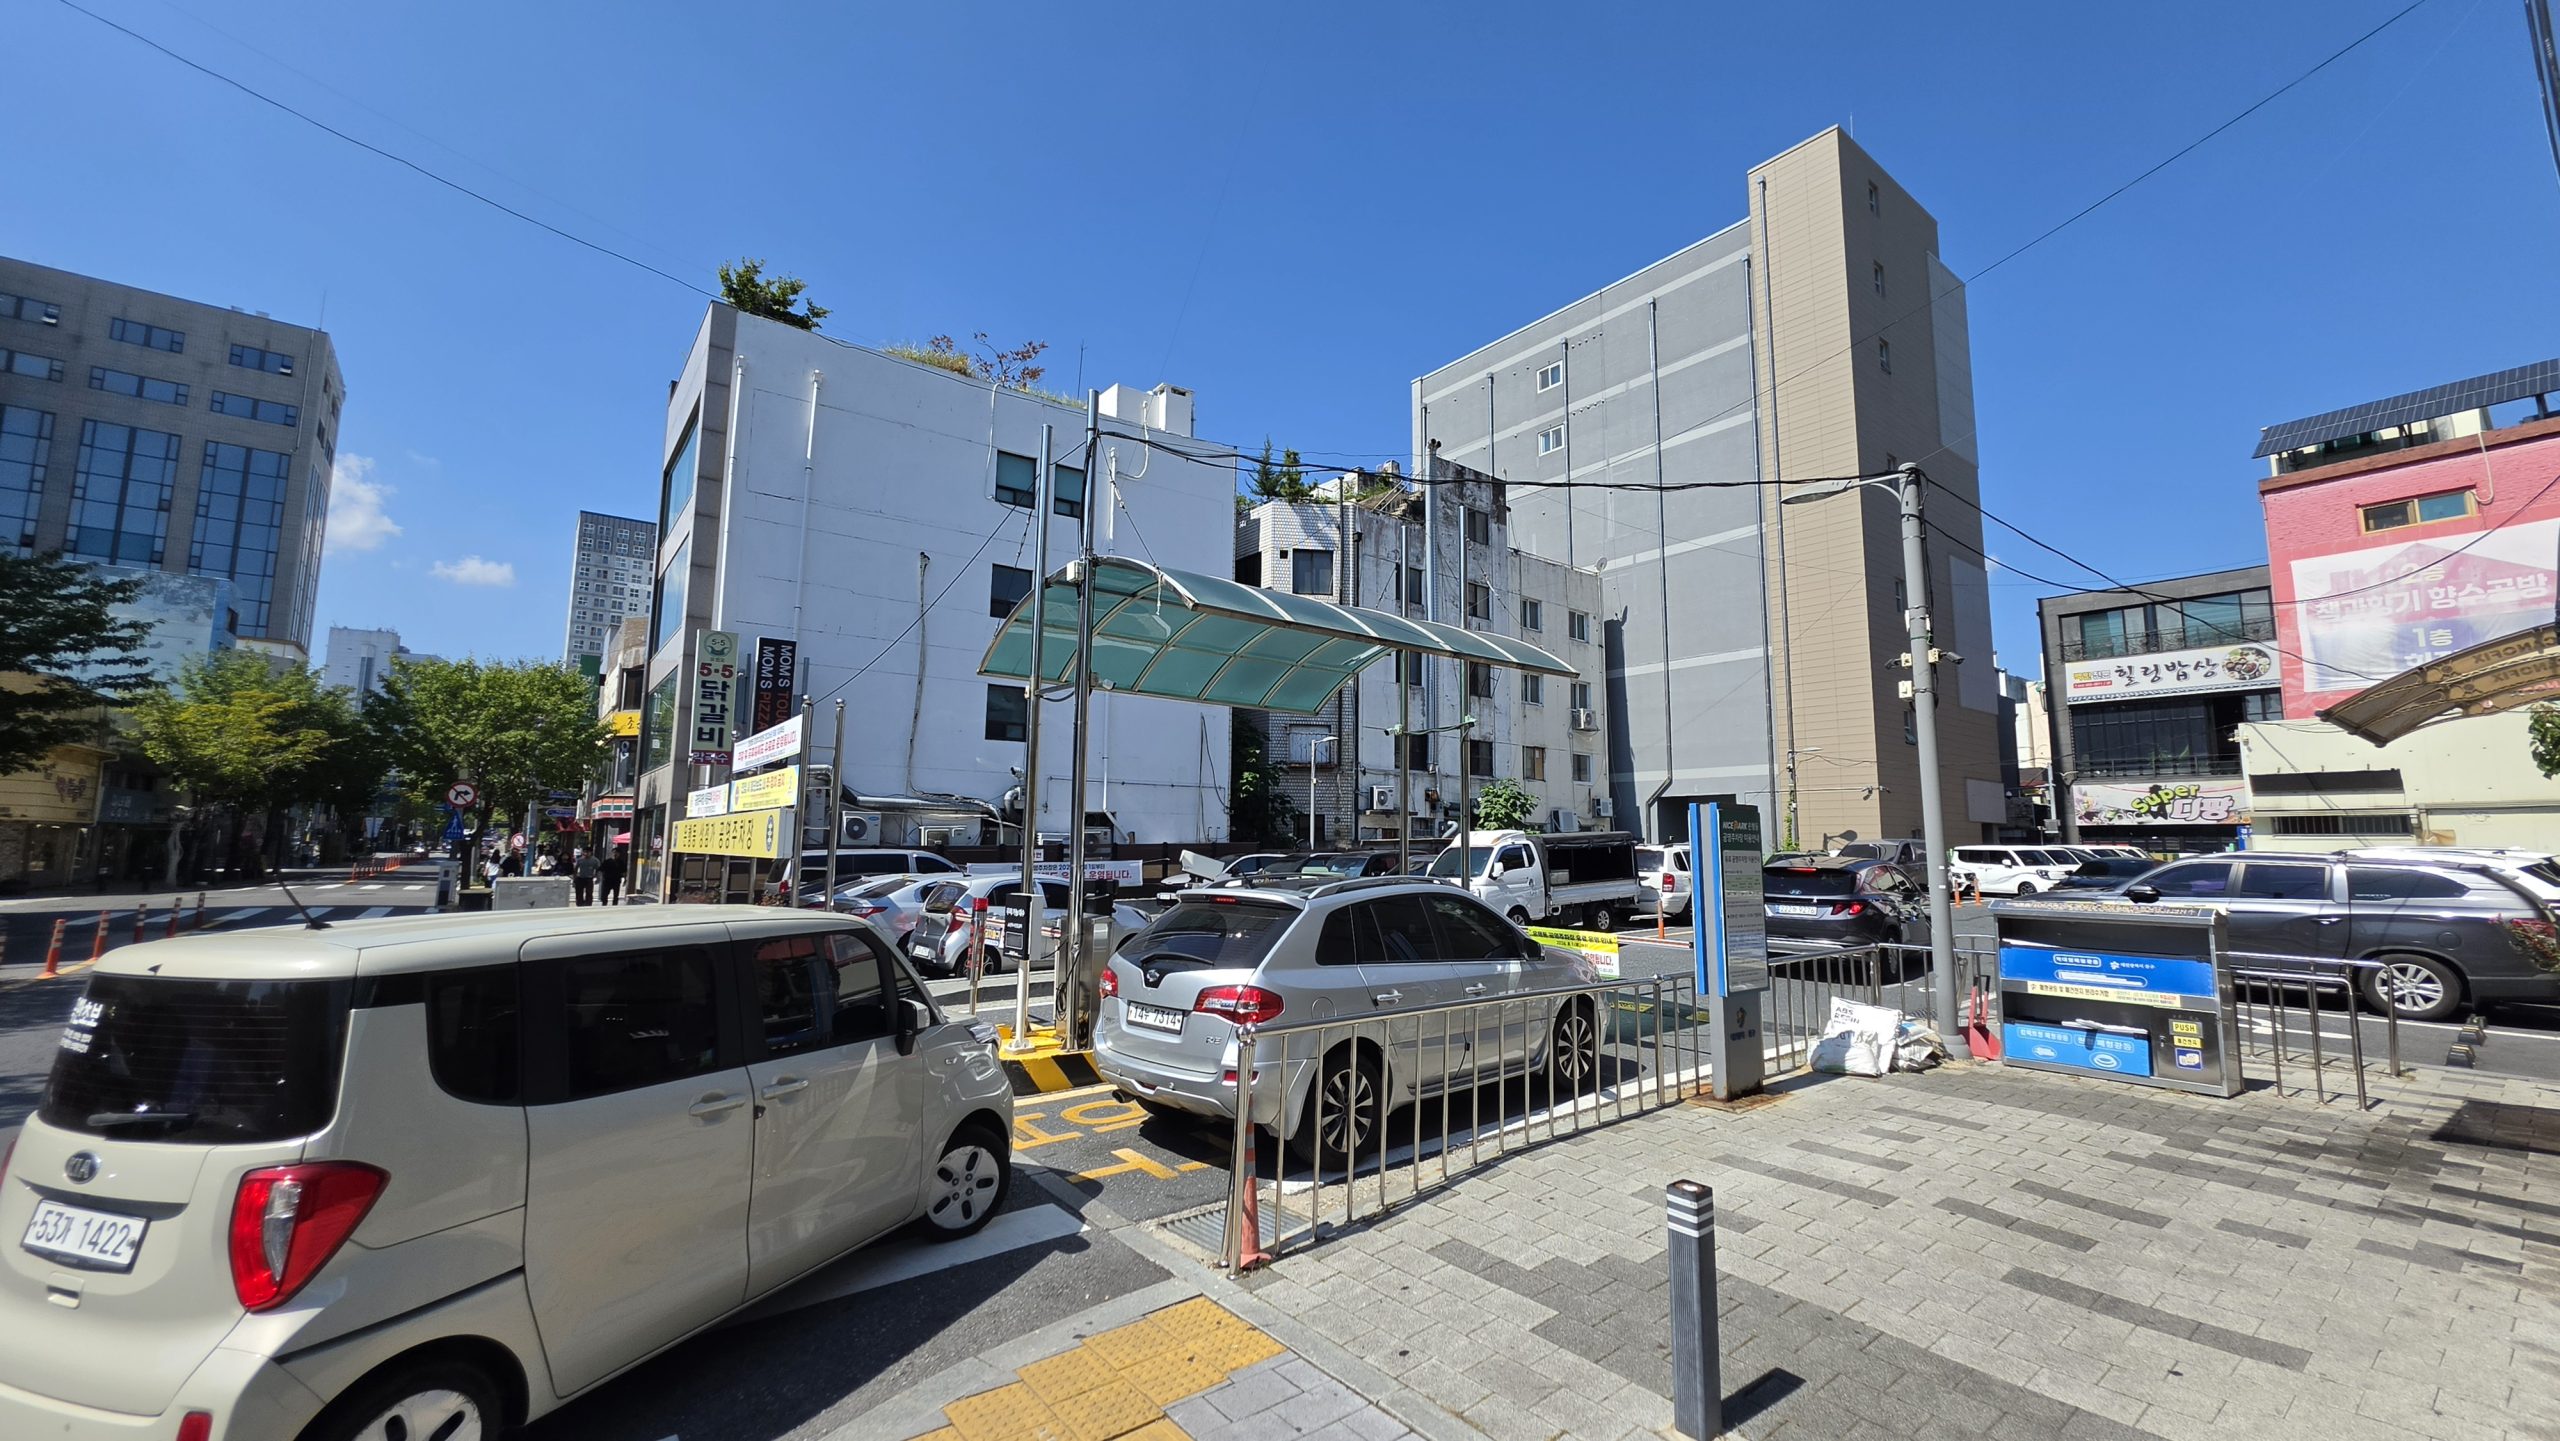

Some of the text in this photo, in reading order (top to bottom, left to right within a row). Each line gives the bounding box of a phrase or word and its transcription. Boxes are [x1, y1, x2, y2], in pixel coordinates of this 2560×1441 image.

[2427, 573, 2549, 609] 향수공방
[2412, 627, 2453, 648] 1층
[697, 679, 731, 750] 닭갈비
[2131, 784, 2200, 814] Super
[718, 819, 754, 850] 공영주차장
[1154, 1009, 1177, 1026] 7314
[1834, 1013, 1860, 1025] RESIN
[1835, 1006, 1854, 1016] ABS
[2174, 1023, 2196, 1033] PUSH
[67, 1156, 92, 1180] KIA
[35, 1209, 132, 1258] 53가 1422
